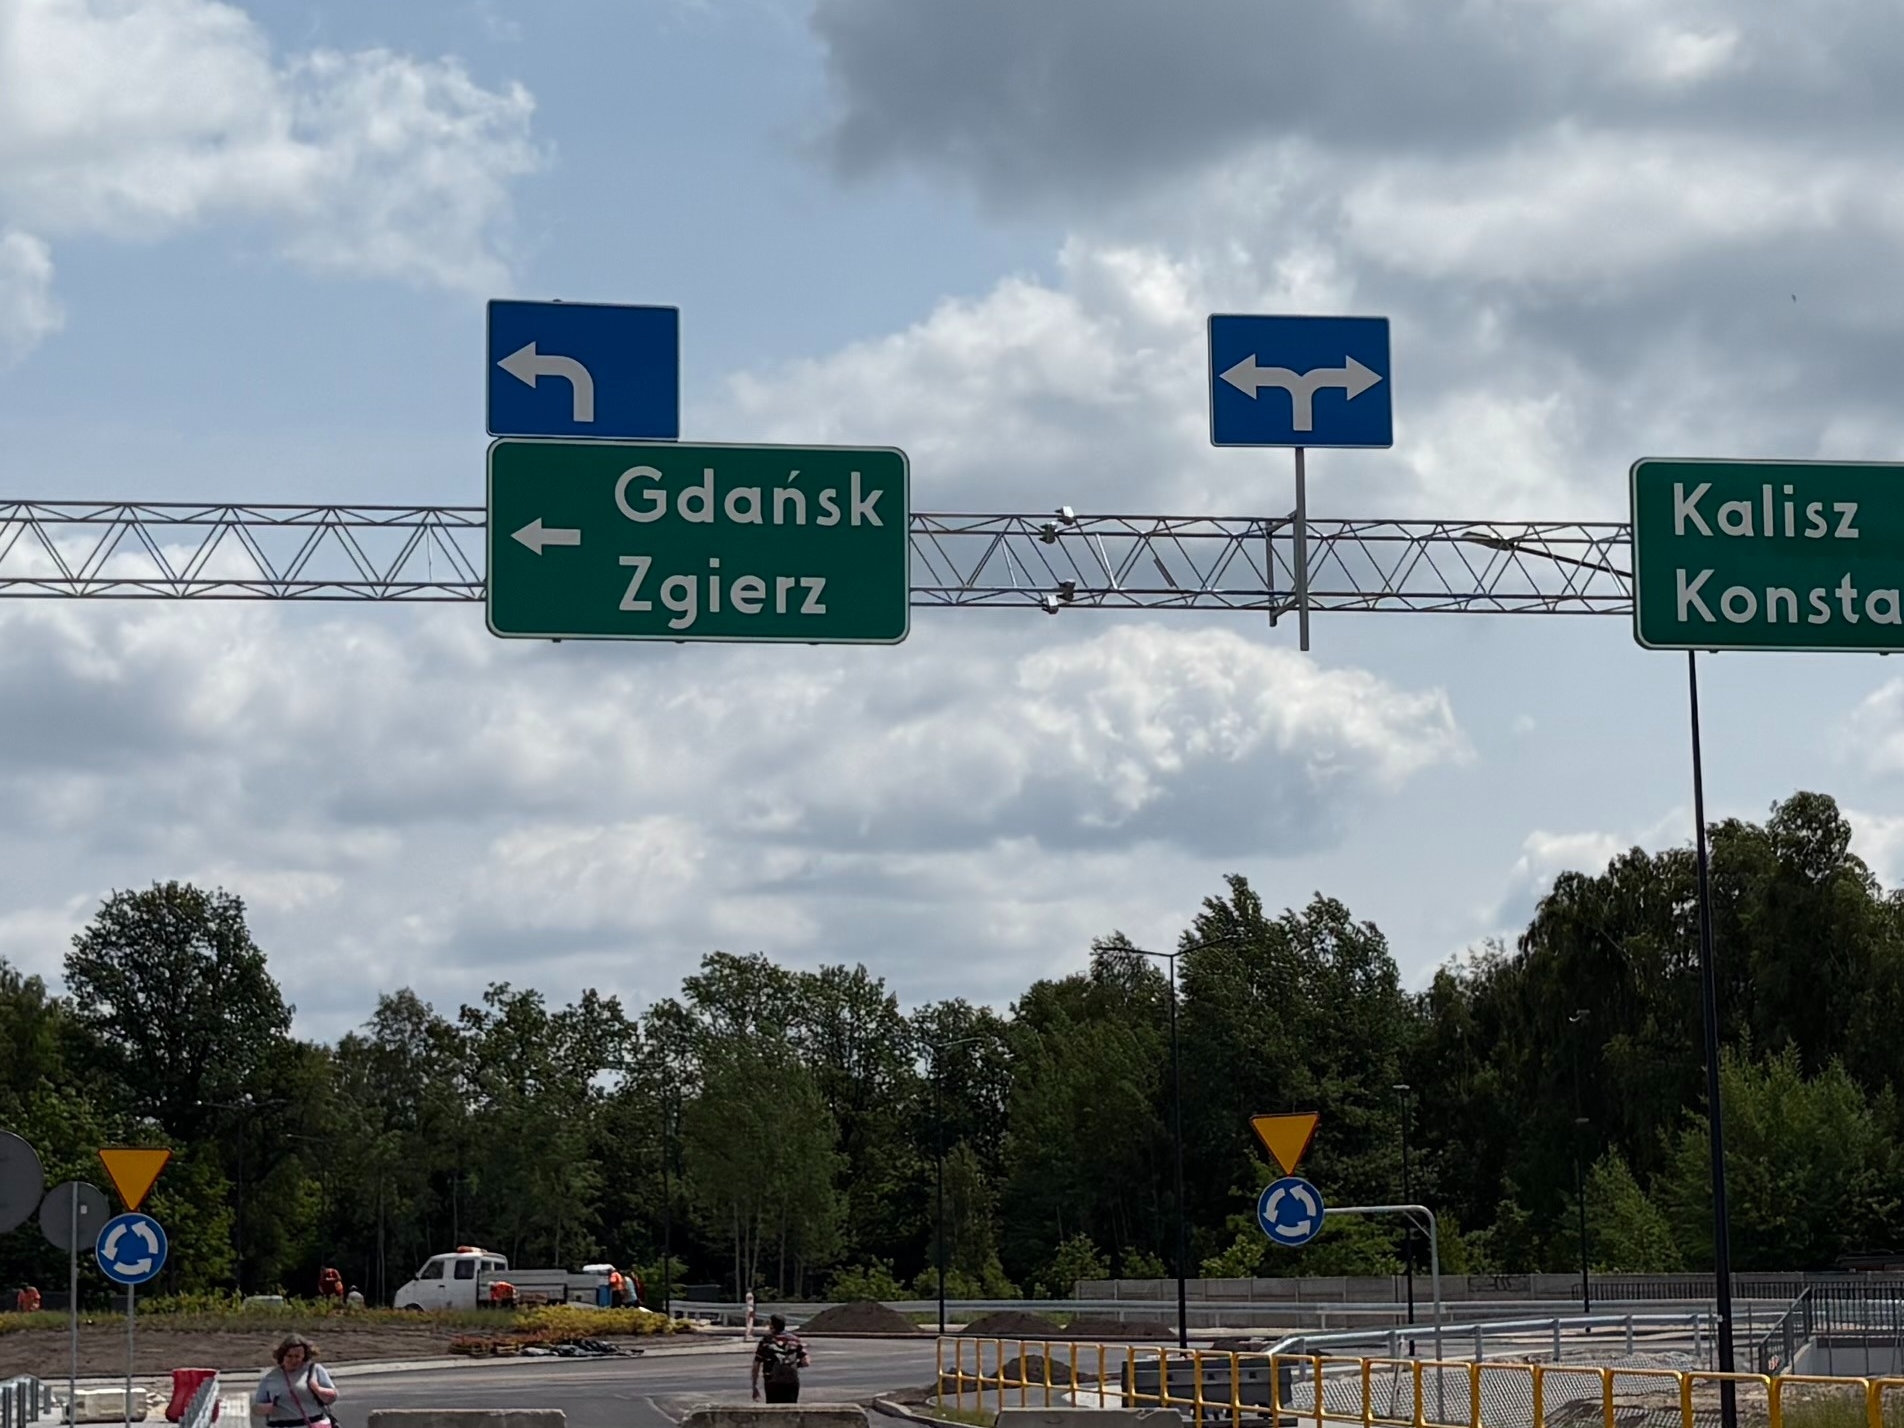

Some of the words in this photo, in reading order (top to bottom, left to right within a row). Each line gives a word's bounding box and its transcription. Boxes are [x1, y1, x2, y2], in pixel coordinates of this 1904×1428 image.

[615, 466, 883, 525] Gdańsk
[1674, 483, 1858, 538] Kalisz
[620, 556, 825, 629] Zgierz
